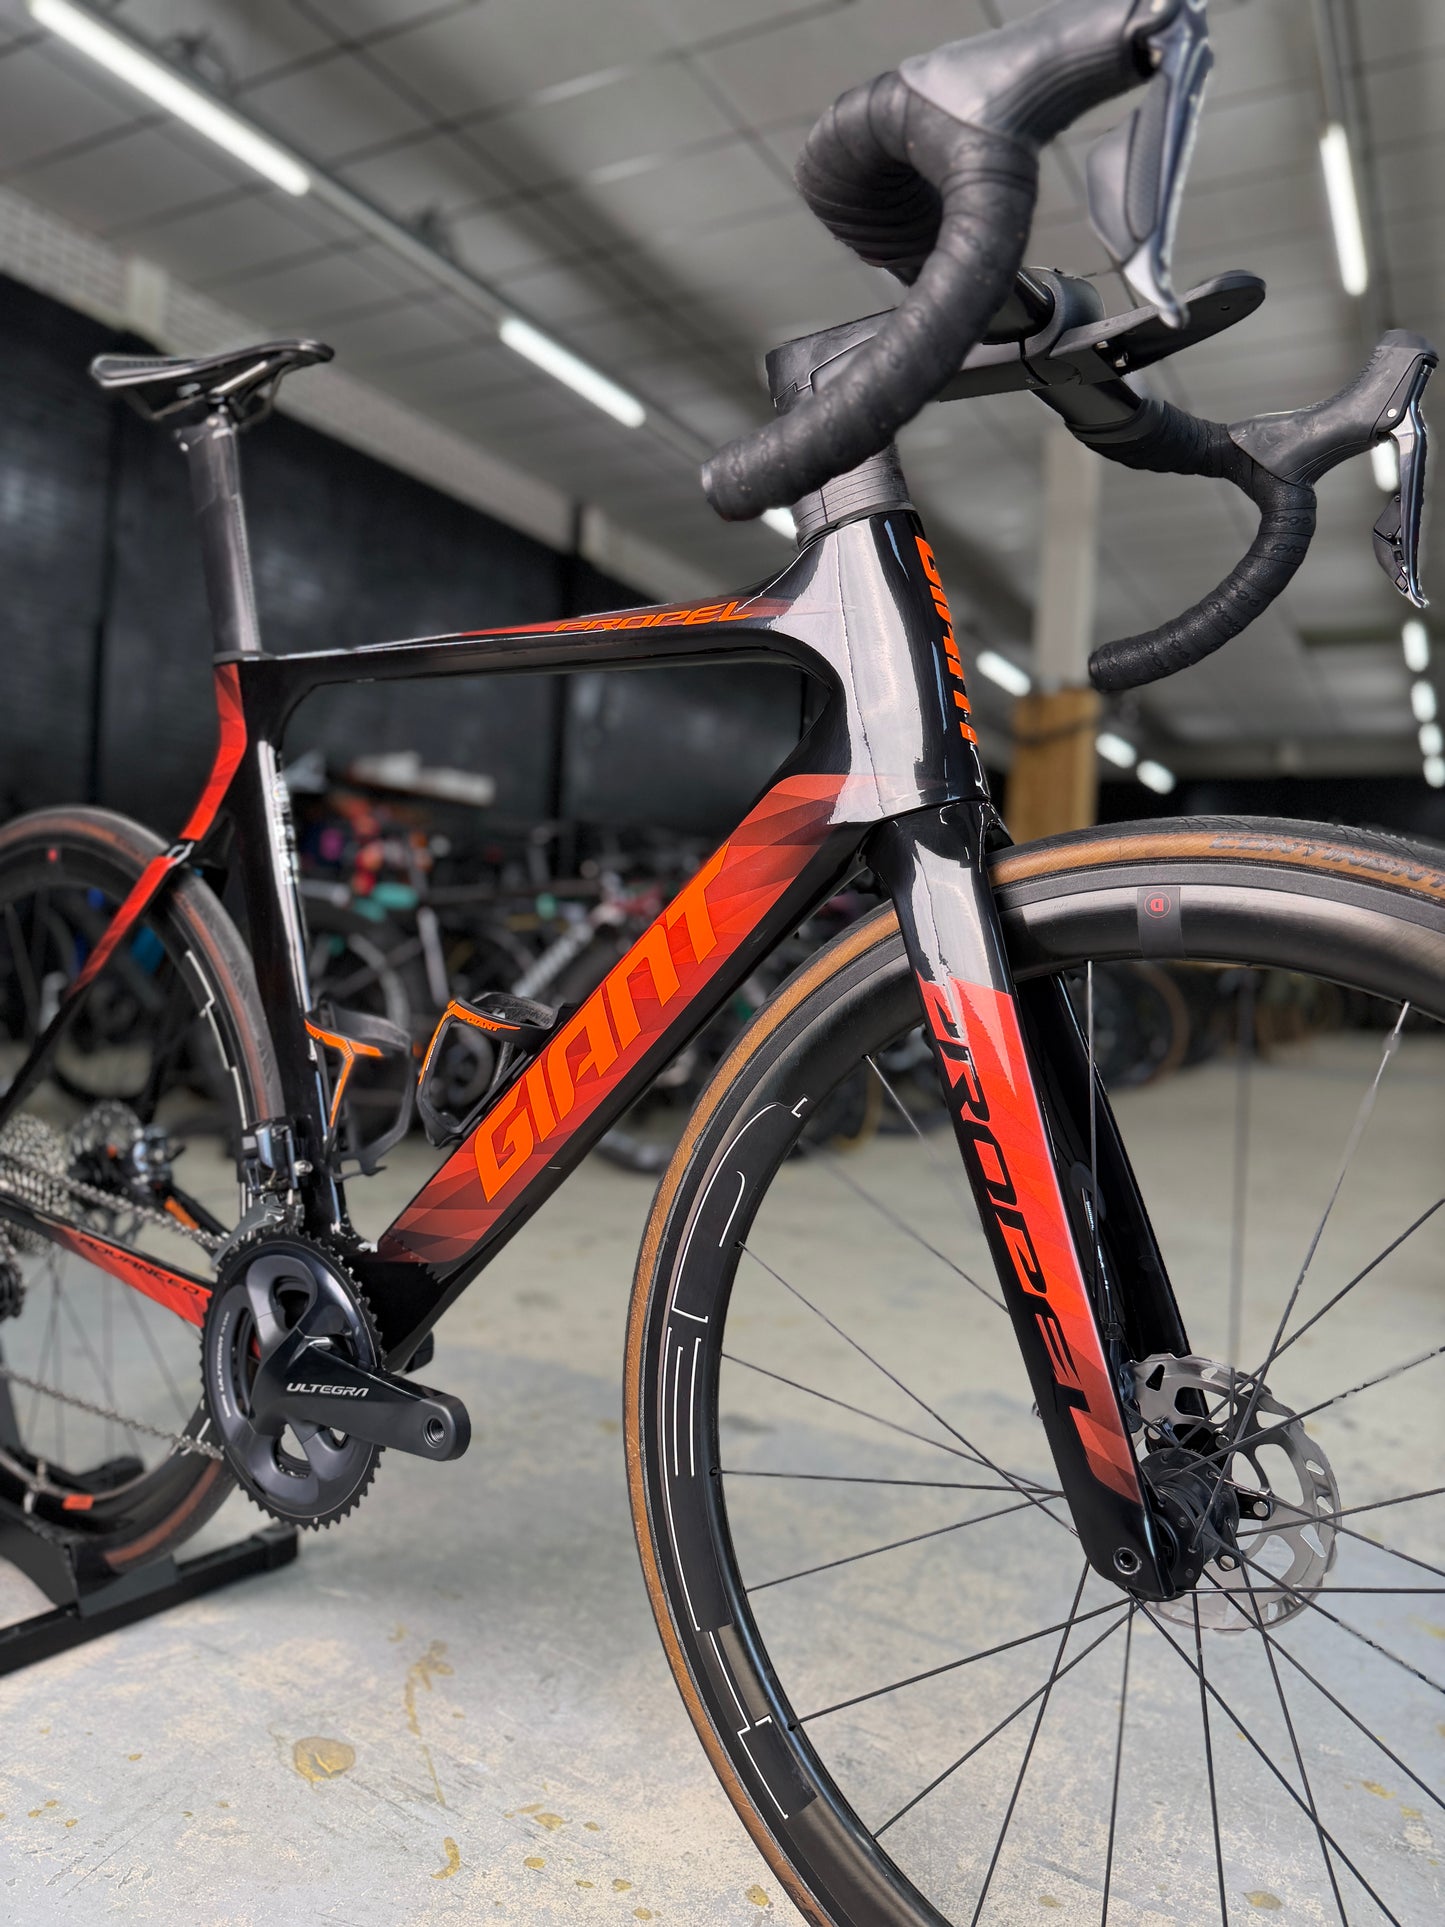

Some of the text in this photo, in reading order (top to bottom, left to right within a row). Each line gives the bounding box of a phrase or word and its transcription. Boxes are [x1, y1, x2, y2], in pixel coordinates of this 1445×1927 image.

[554, 601, 752, 632] PROPEL
[474, 840, 730, 1203] GIANT
[914, 964, 1093, 1462] PROPEL
[286, 1382, 369, 1398] ULTEGRA
